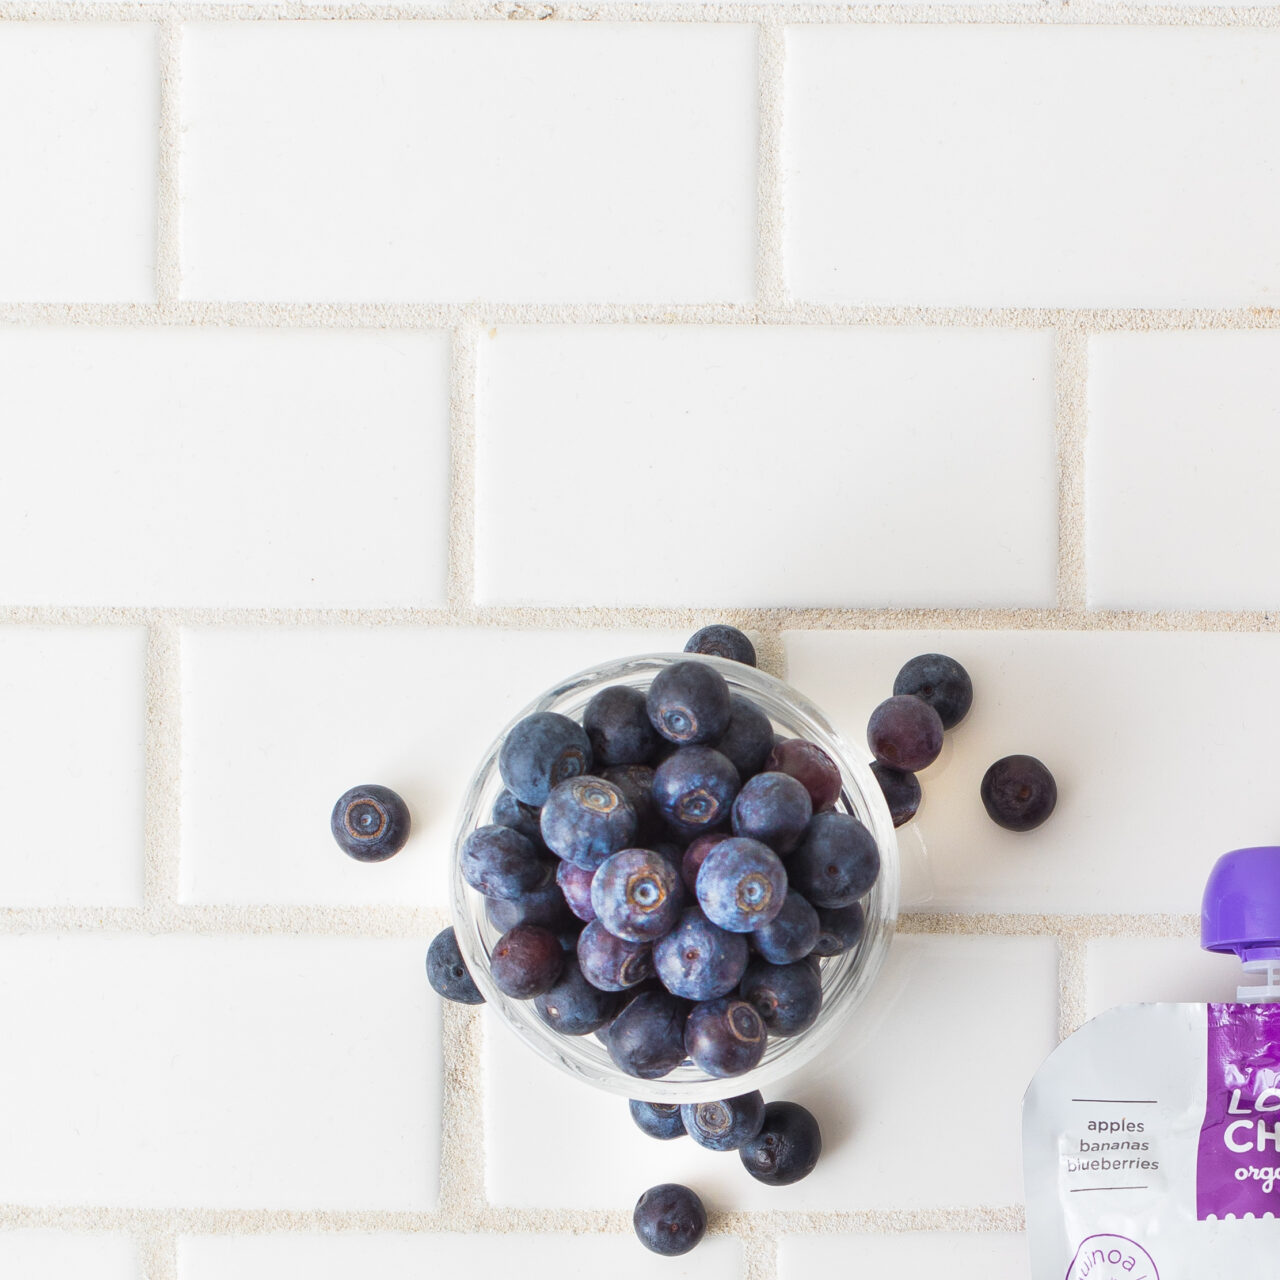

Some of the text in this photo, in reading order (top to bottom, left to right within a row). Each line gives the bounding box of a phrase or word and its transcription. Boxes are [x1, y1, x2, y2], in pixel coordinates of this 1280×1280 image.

[1087, 1118, 1145, 1134] apples
[1079, 1138, 1150, 1152] bananas
[1067, 1157, 1160, 1173] blueberries
